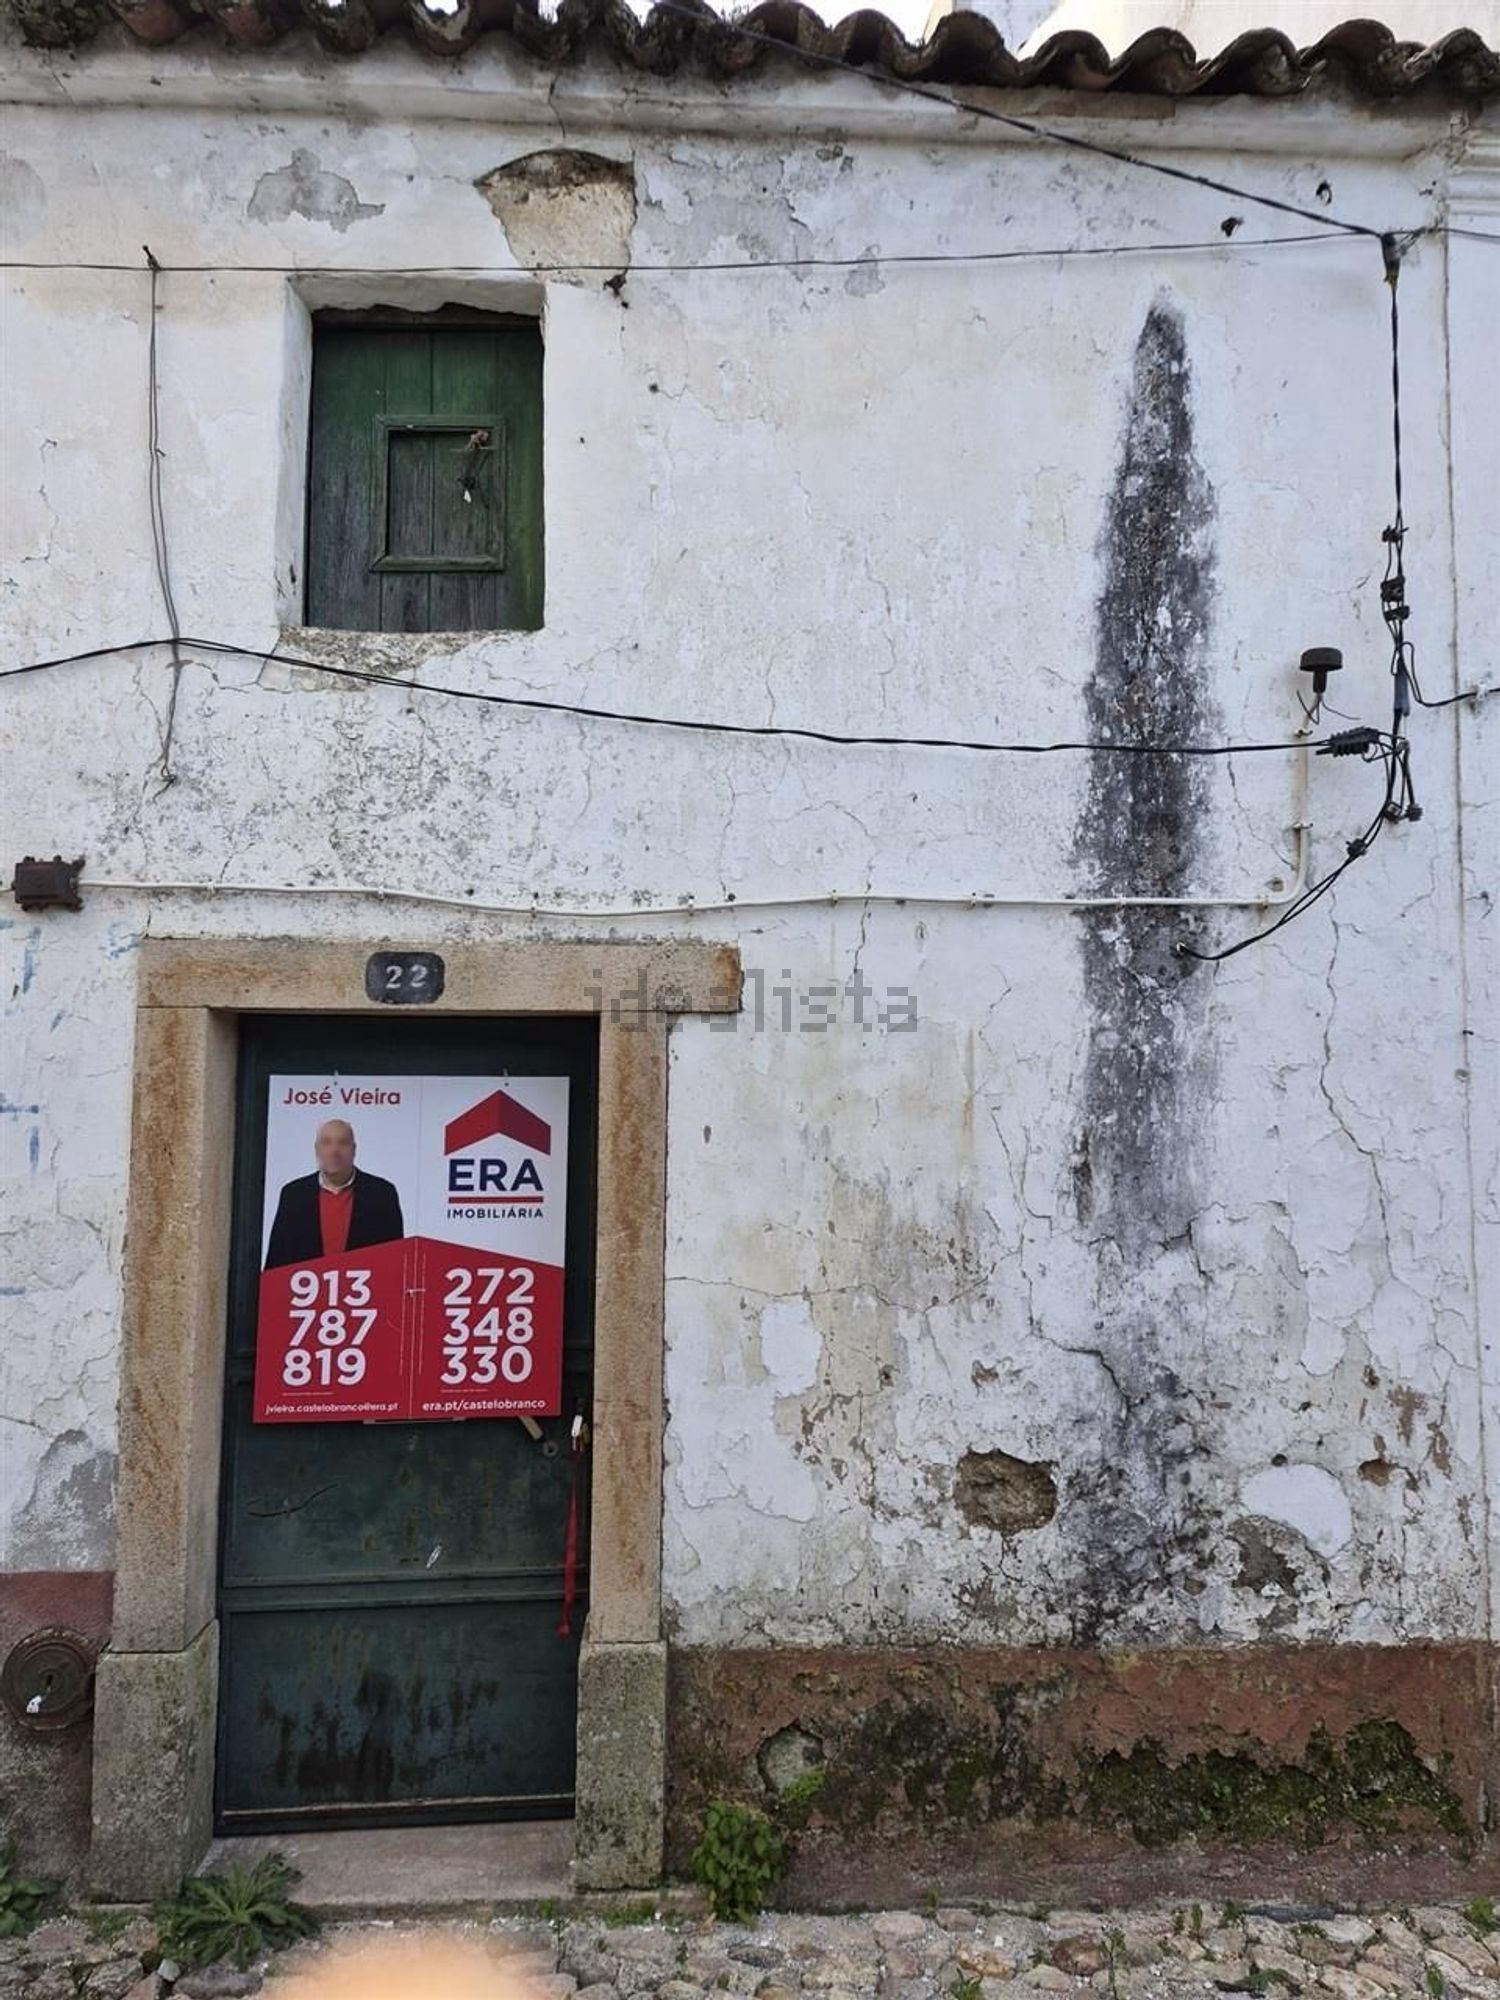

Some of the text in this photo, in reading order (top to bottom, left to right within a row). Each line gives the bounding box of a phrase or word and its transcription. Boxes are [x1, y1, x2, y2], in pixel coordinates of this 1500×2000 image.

[385, 964, 428, 989] 22
[283, 1086, 401, 1105] José Vieira
[448, 1158, 544, 1192] ERA
[447, 1206, 544, 1219] IMOBILIÁRIA
[289, 1270, 372, 1307] 913
[443, 1267, 535, 1305] 272
[288, 1309, 378, 1347] 787
[443, 1307, 534, 1344] 348
[282, 1348, 366, 1386] 819
[440, 1345, 533, 1384] 330
[265, 1401, 399, 1415] jvieira.castelobranco@era.pt
[422, 1398, 546, 1413] era.pt/castelobranco
